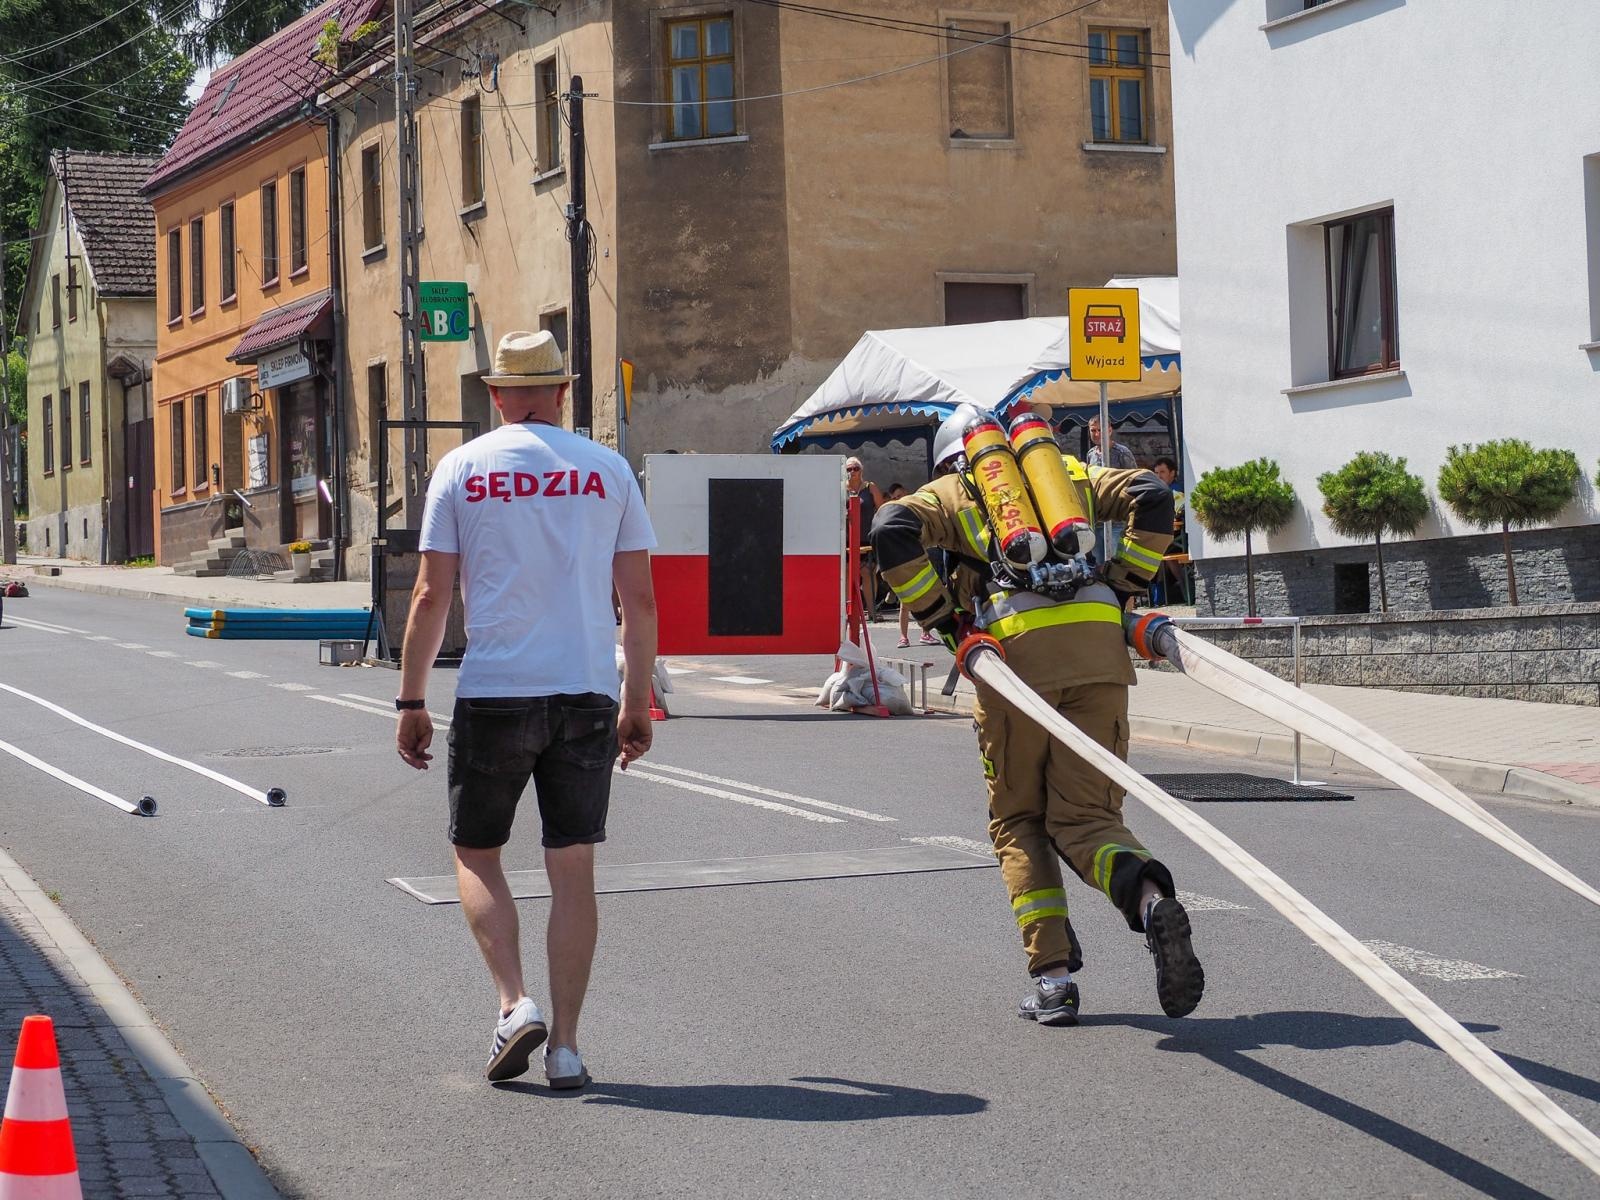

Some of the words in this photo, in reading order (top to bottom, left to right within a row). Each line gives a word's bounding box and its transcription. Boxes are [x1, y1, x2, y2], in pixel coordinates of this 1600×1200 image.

[420, 310, 465, 336] ABC
[1088, 319, 1121, 332] STRAŻ
[270, 357, 284, 372] SKLEP
[1085, 355, 1125, 368] Wyjazd
[465, 470, 606, 503] SĘDZIA
